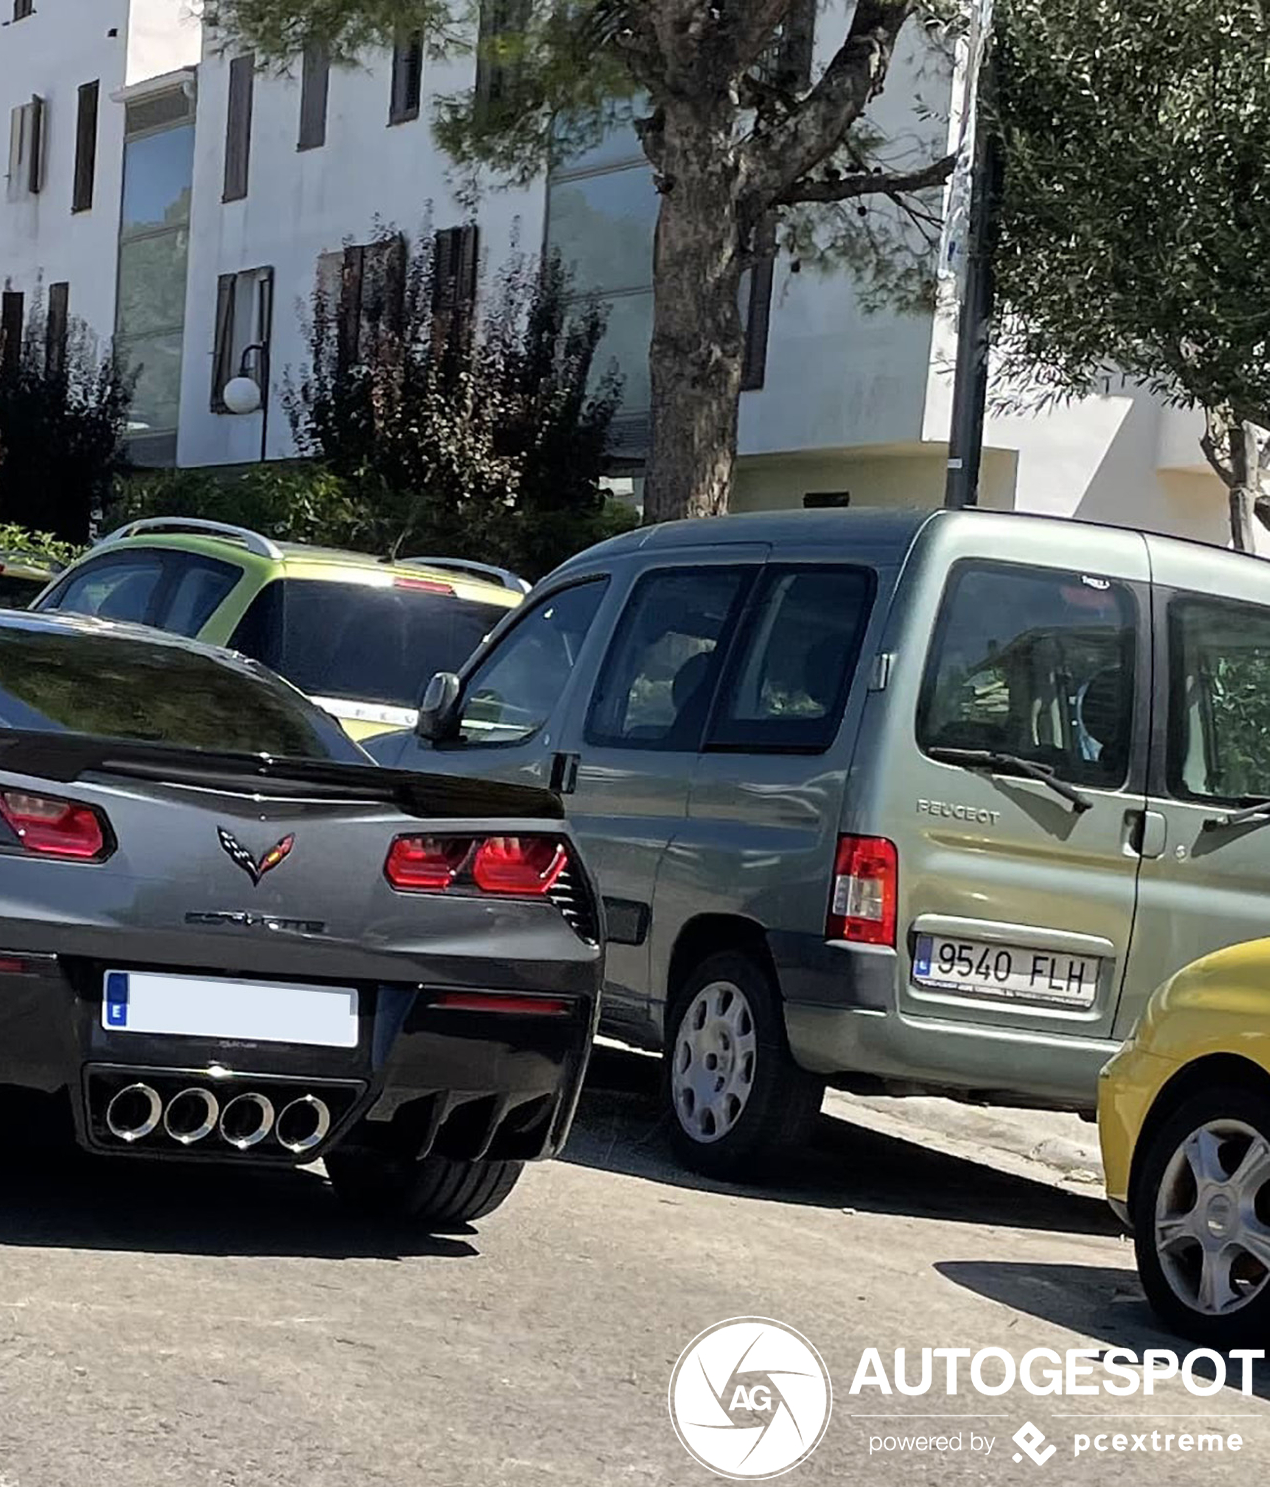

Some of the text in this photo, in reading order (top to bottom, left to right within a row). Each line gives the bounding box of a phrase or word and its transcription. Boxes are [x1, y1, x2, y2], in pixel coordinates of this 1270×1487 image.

[917, 799, 1000, 825] PEUGEOT
[938, 943, 1012, 982] 9540
[1030, 956, 1085, 994] FLH
[112, 1004, 121, 1018] E
